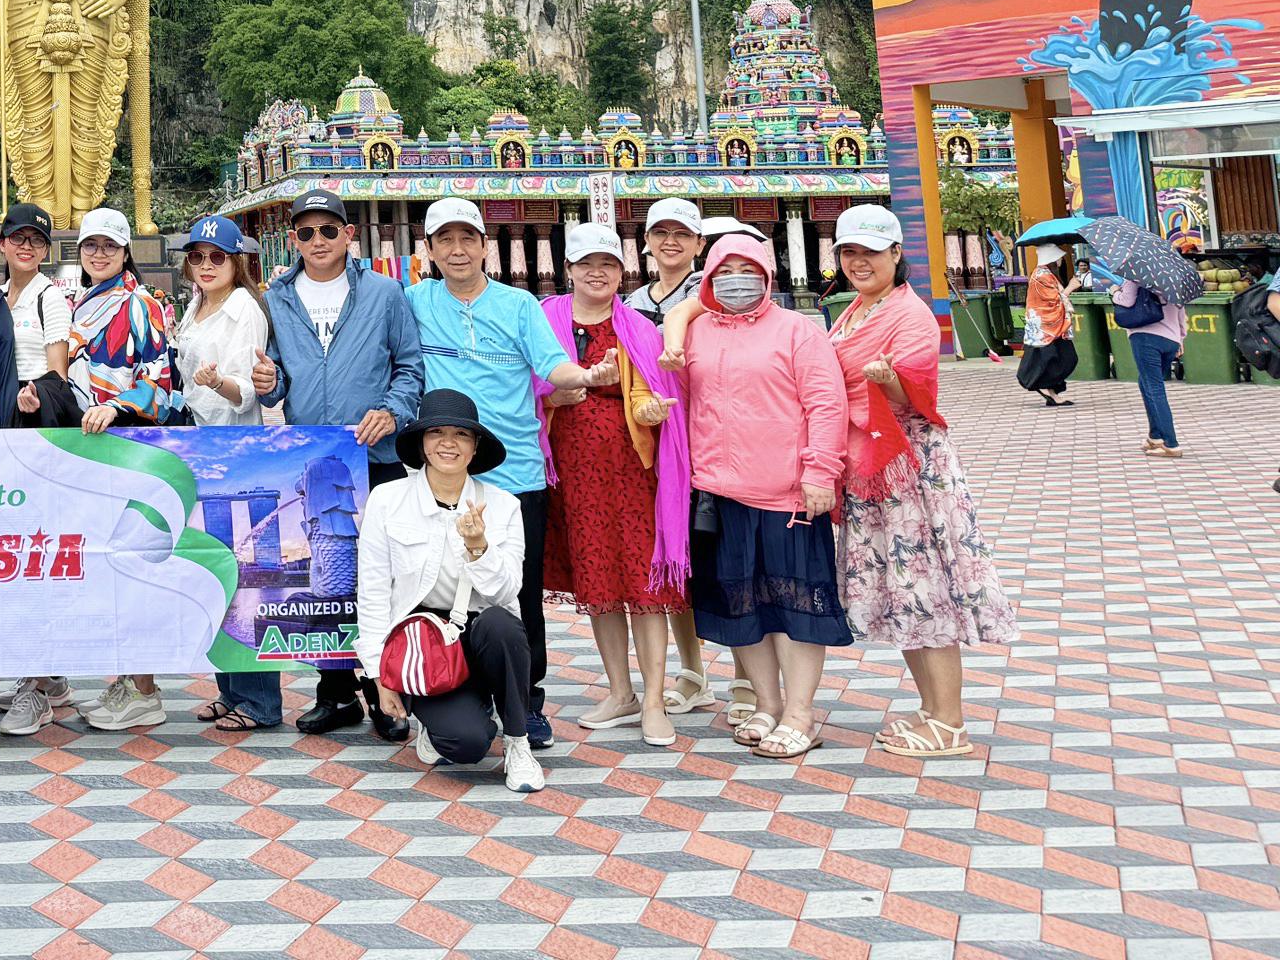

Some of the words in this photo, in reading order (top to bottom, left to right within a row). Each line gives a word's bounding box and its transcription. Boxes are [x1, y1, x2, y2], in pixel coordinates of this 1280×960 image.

[597, 212, 609, 223] NO
[201, 220, 218, 238] NY
[257, 602, 341, 616] ORGANIZED
